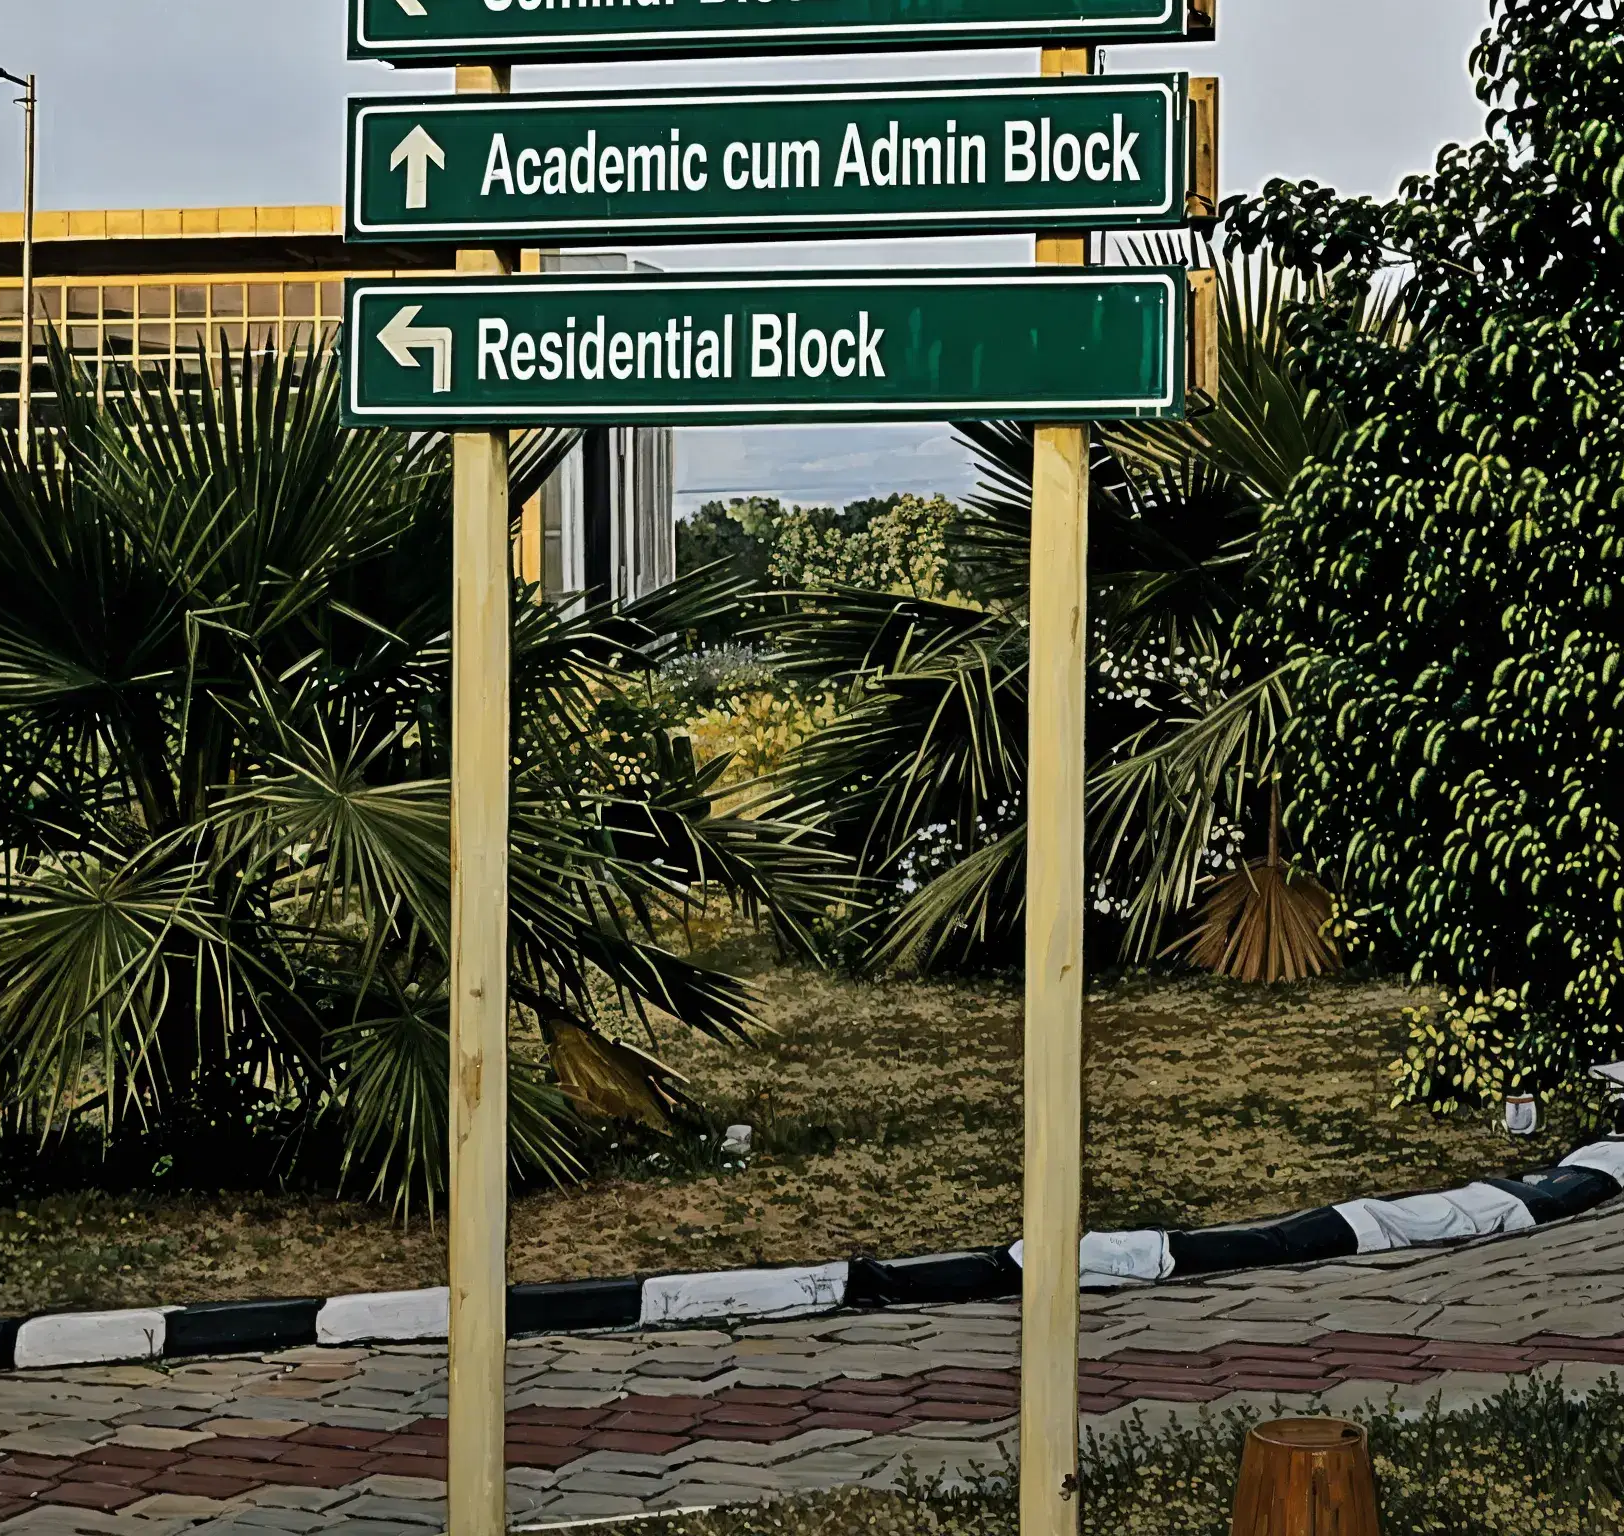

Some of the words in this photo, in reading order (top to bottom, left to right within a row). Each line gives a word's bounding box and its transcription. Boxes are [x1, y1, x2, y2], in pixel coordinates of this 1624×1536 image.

[480, 128, 708, 196] Academic
[723, 139, 820, 190] cum
[833, 119, 986, 187] Admin
[1004, 113, 1141, 183] Block
[477, 313, 733, 381] Residential
[751, 310, 886, 378] Block
